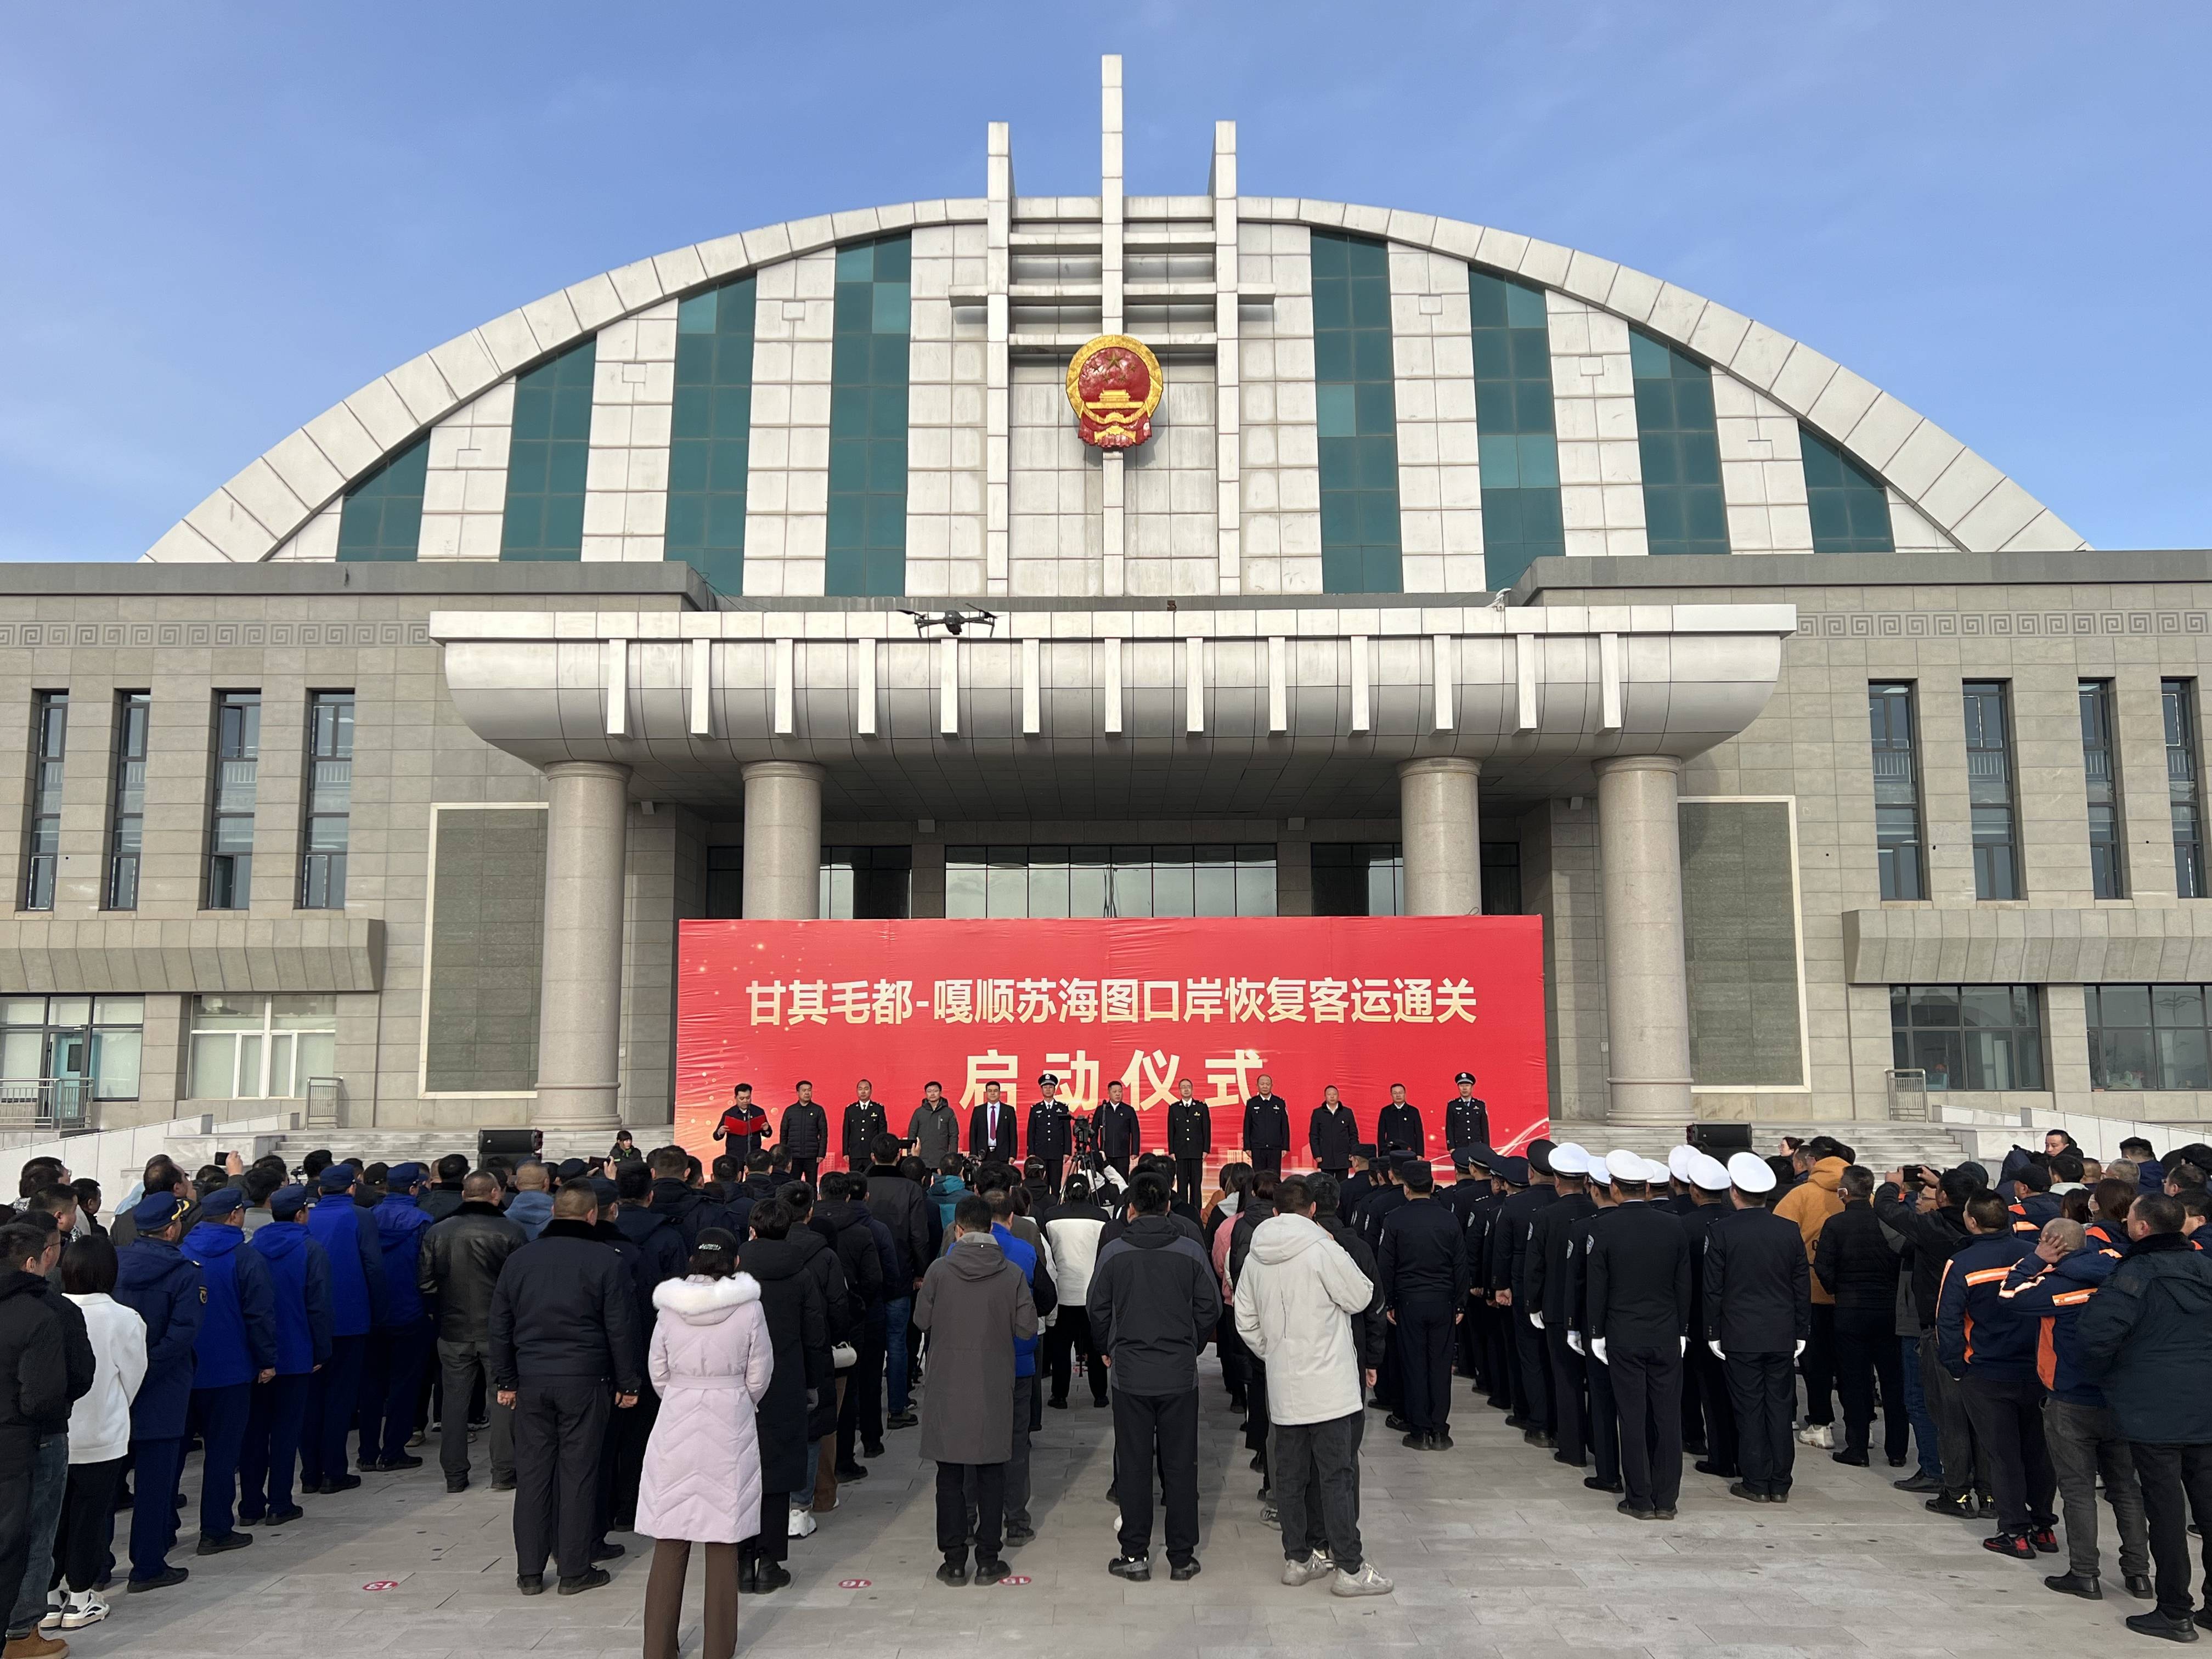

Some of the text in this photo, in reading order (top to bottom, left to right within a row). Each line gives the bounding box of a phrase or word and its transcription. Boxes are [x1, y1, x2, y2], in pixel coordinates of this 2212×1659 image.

[745, 977, 1477, 1026] 甘其毛都-嘎顺苏海图口岸恢复客运通关
[959, 1049, 1263, 1113] 启动仪式
